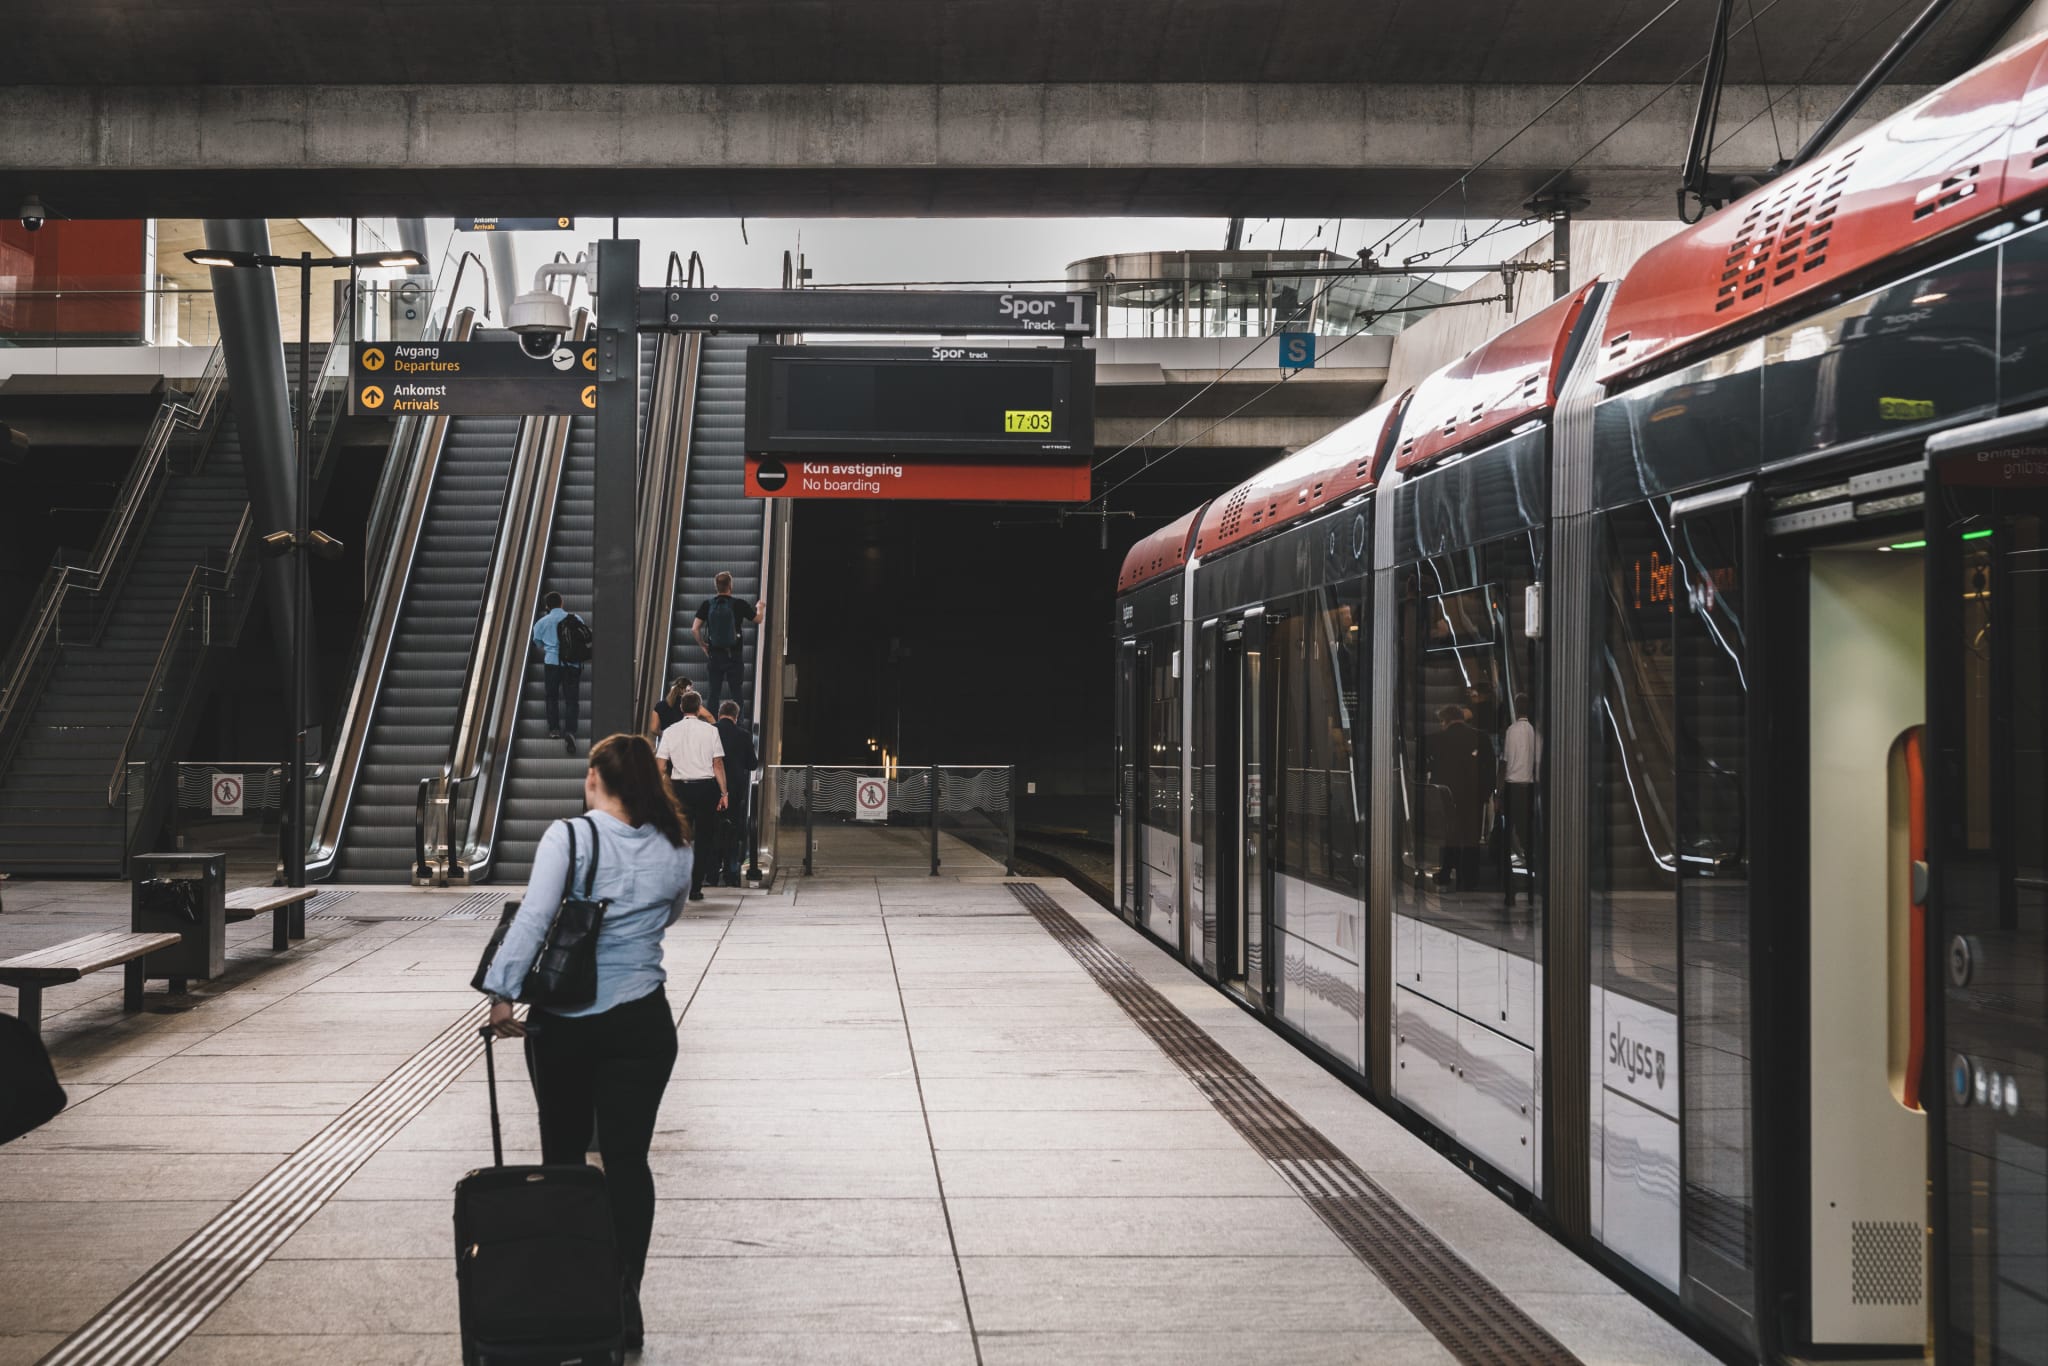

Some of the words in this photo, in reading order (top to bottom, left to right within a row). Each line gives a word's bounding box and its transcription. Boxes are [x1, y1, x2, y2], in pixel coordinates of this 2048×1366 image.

[1000, 294, 1056, 319] Spor
[1065, 295, 1090, 331] 1
[1021, 319, 1056, 330] Track
[394, 345, 440, 360] Avgang
[931, 347, 965, 361] Spor
[1287, 339, 1307, 362] S
[394, 360, 461, 374] Departures
[393, 383, 447, 396] Ankomst
[393, 398, 440, 410] Arrivals
[1007, 414, 1051, 430] 17:03
[803, 462, 830, 475] Kun
[832, 463, 903, 478] avstigning
[803, 478, 821, 491] No
[823, 478, 881, 494] boarding
[1609, 1021, 1653, 1084] skyss
